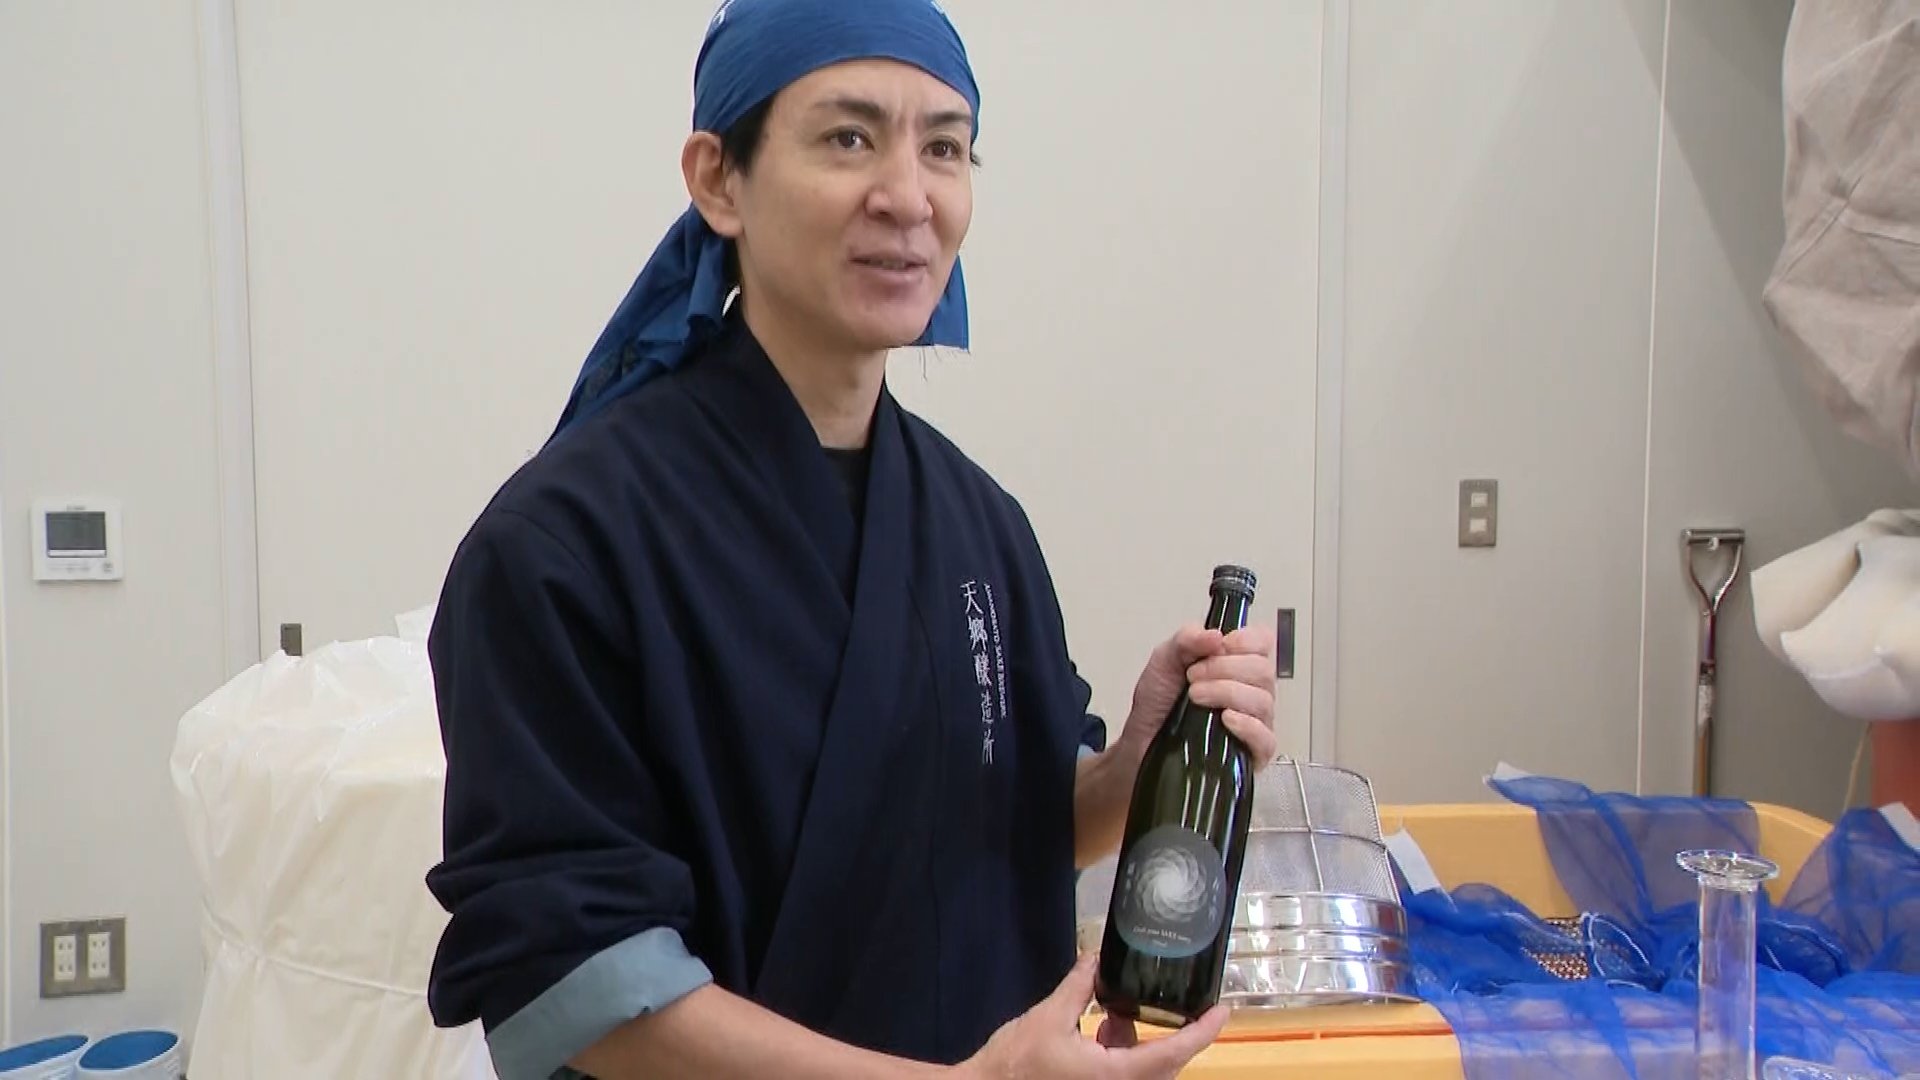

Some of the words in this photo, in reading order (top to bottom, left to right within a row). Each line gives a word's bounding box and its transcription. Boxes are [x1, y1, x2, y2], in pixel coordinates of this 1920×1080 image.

[960, 579, 995, 765] 天郷醸造所
